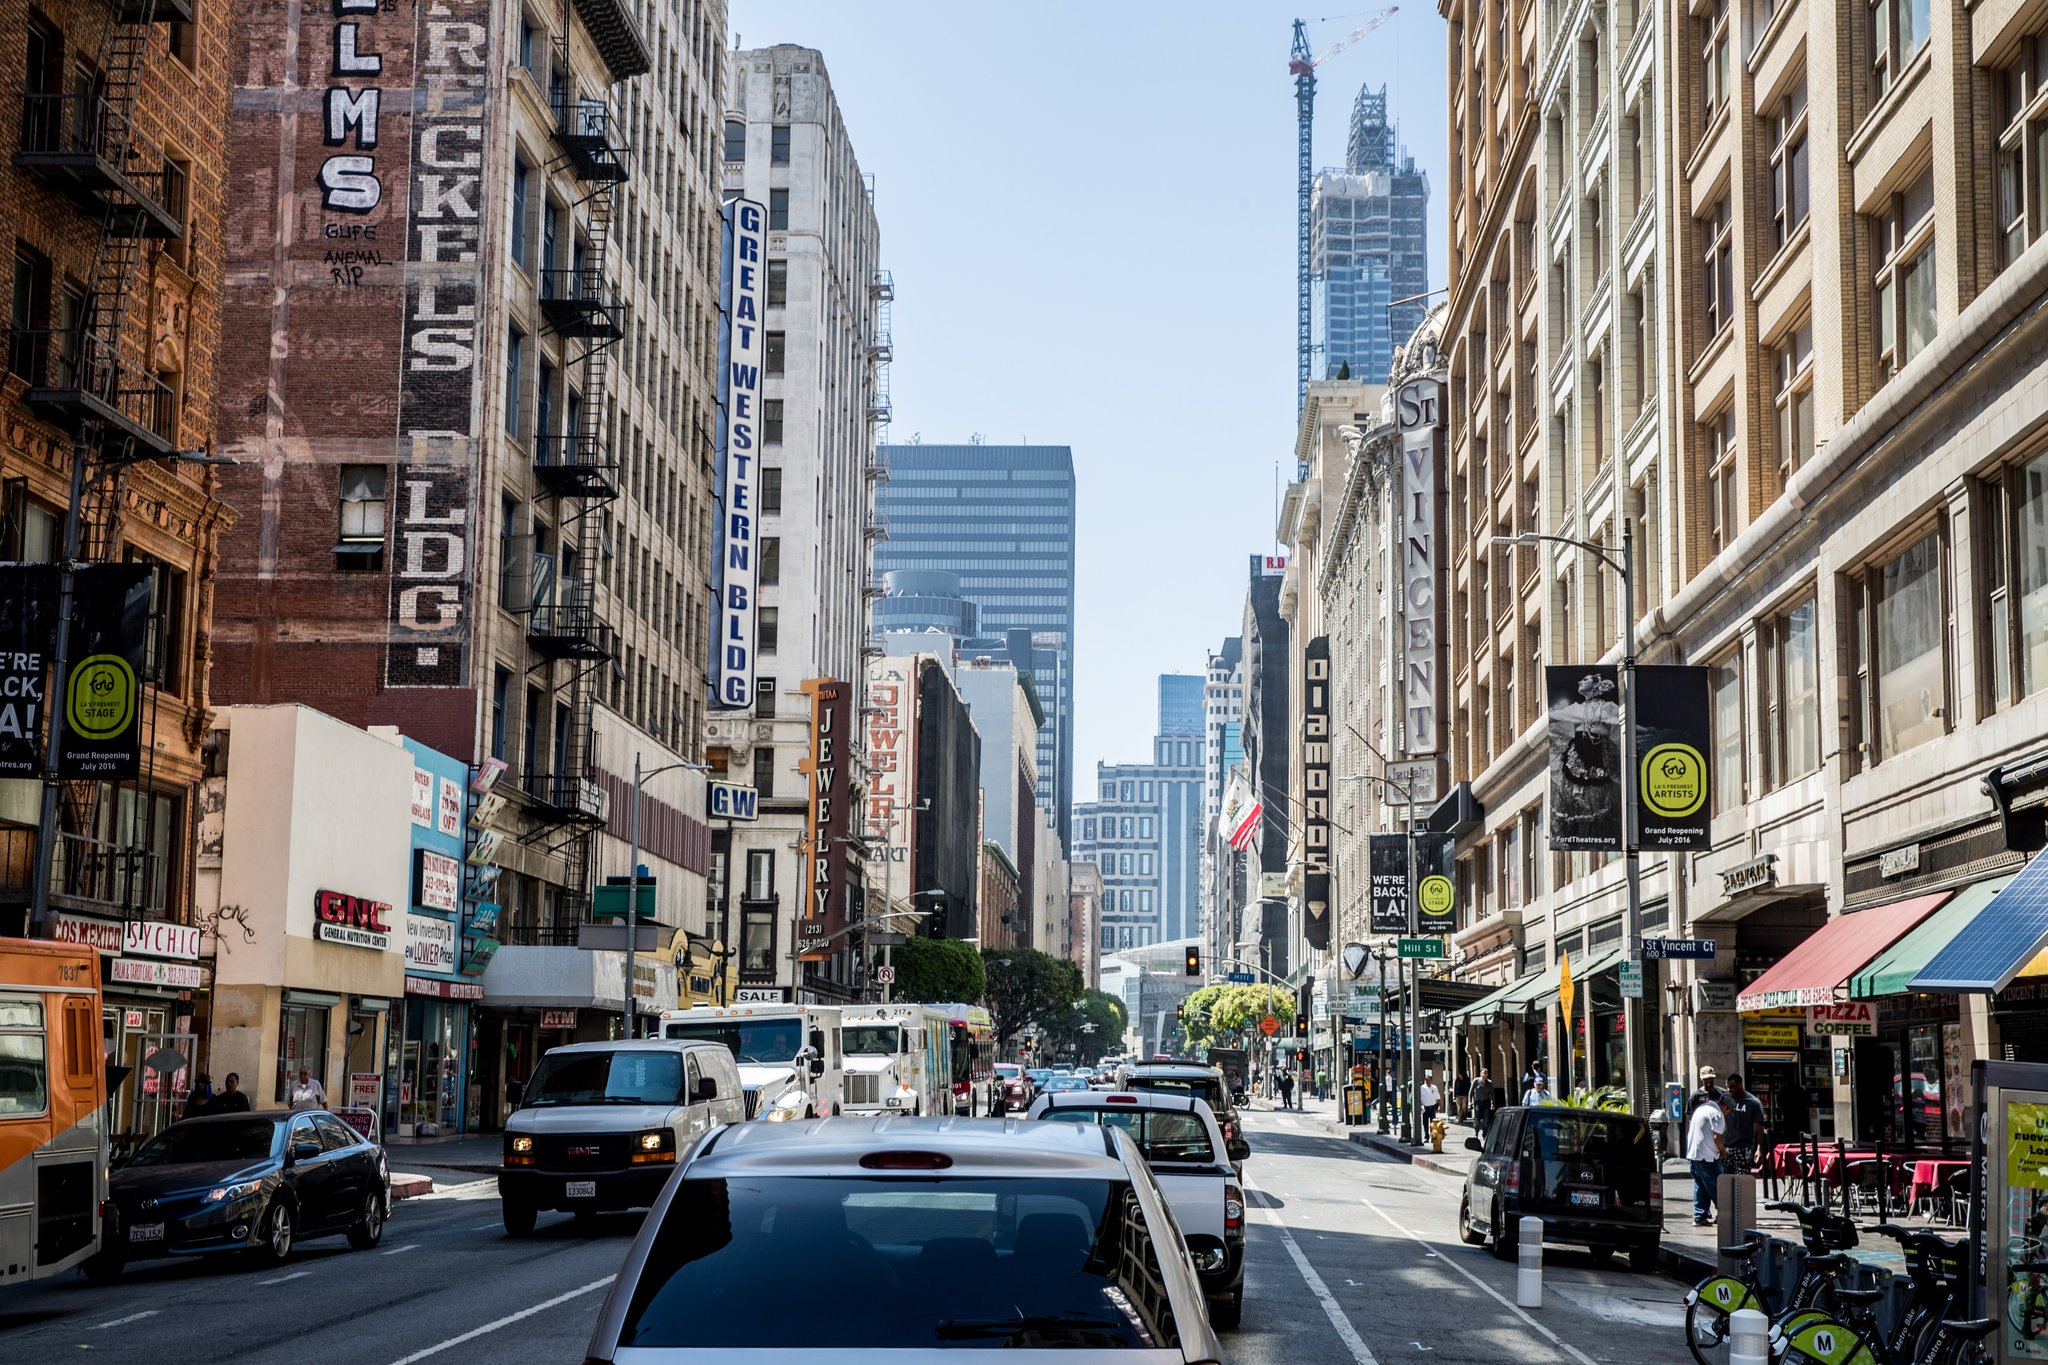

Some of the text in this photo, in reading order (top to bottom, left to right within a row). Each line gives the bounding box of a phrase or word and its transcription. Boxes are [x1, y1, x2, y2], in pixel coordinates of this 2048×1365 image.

[725, 206, 760, 703] GREAT WESTERN BLDG
[1407, 447, 1433, 738] VINCENT
[85, 708, 116, 718] STAGE
[67, 752, 130, 761] Grand Reopening
[80, 763, 97, 771] July
[713, 786, 756, 817] GW
[1654, 790, 1694, 798] ARTISTS
[814, 708, 834, 913] JEWELRY
[443, 814, 457, 831] OFF
[1667, 827, 1704, 836] Reopening
[1556, 836, 1616, 844] FordTheatres.org
[1657, 836, 1691, 844] July 2016
[1373, 875, 1405, 885] WE'RE
[1373, 886, 1408, 899] BACK,
[319, 890, 392, 932] GNC
[1373, 899, 1406, 917] LA!
[79, 922, 122, 952] MEXICO
[324, 926, 387, 947] GENERAL NUTRITION CENTER
[414, 941, 439, 963] LOWER
[439, 947, 453, 964] Prices
[1404, 944, 1437, 953] Hill St
[1646, 940, 1714, 952] St Vincent Ct
[58, 965, 79, 982] 7837
[1621, 962, 1628, 972] 2
[1620, 973, 1641, 981] PARKING
[739, 991, 779, 1001] SALE
[2002, 985, 2035, 1001] VINCENT
[543, 1011, 574, 1025] ATM
[1813, 1003, 1871, 1021] PIZZA
[1814, 1022, 1872, 1035] COFFEE
[354, 1084, 377, 1094] FREE
[1979, 1156, 1988, 1276] Metro Bike
[1794, 1271, 1812, 1310] Metro Bike
[1894, 1308, 1917, 1352] Metro Bike
[1817, 1333, 1832, 1351] M
[1924, 1340, 1942, 1364] Metro
